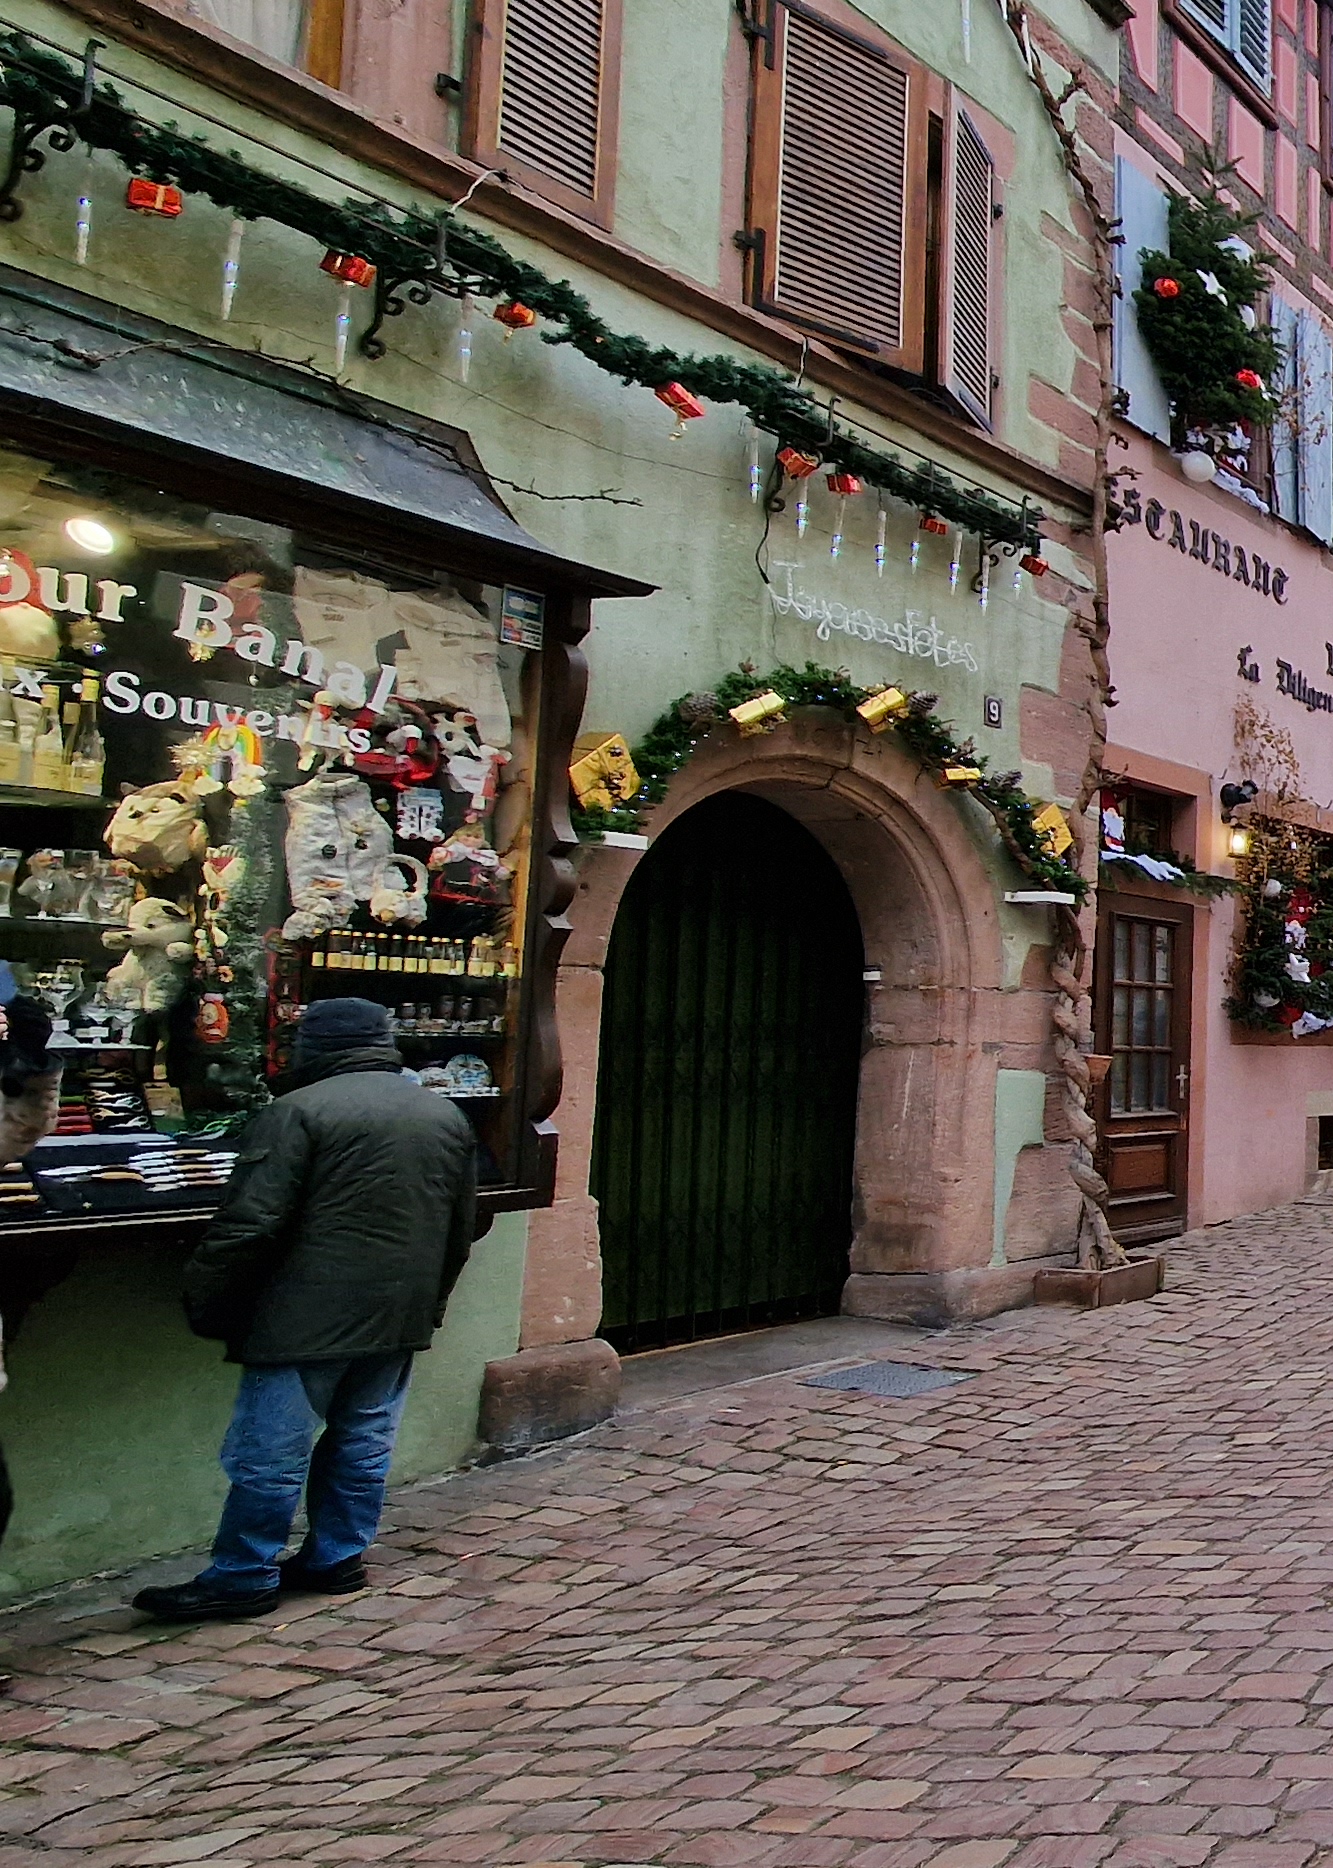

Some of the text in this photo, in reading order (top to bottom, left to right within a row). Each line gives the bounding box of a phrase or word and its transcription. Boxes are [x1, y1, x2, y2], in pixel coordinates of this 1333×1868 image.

[1103, 476, 1289, 605] STAURANT
[172, 580, 397, 714] Banal
[1237, 645, 1261, 684] La
[102, 671, 371, 753] Souvenirs
[990, 701, 999, 721] 9
